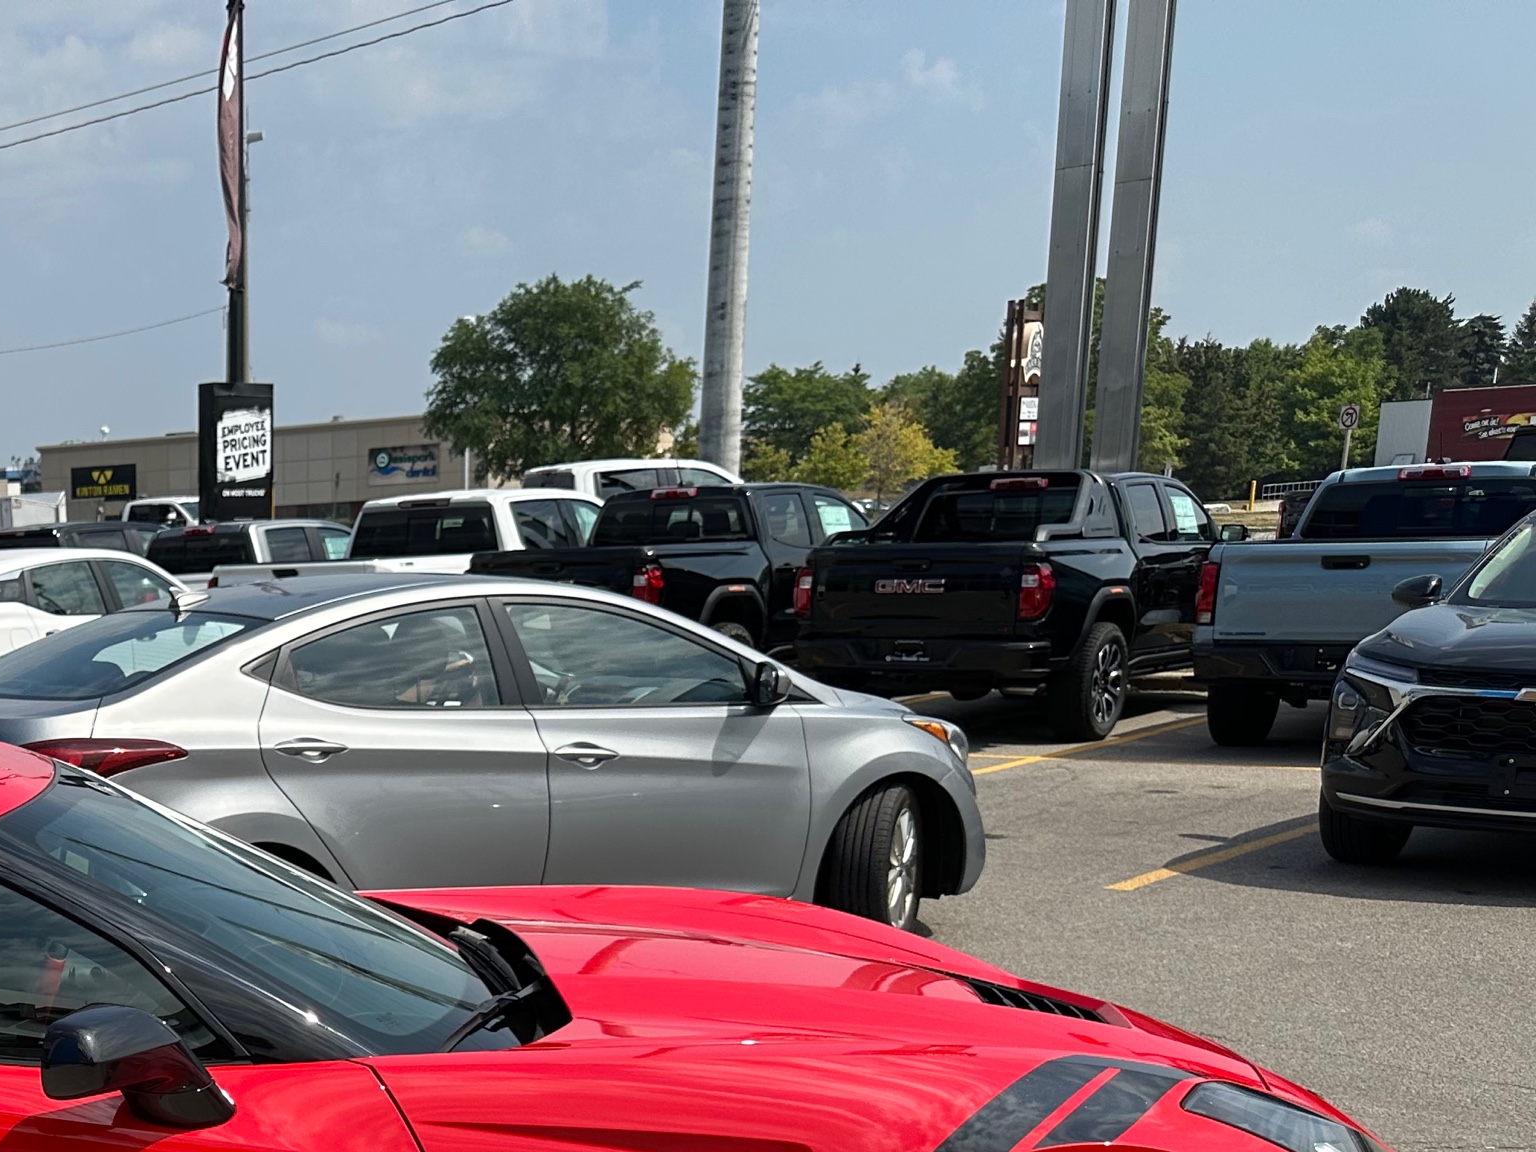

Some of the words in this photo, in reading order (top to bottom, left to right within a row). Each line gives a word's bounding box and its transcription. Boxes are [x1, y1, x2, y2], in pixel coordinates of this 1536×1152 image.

[221, 420, 266, 438] EMPLOYEE
[223, 433, 267, 453] PRICING
[224, 449, 267, 472] EVENT
[875, 579, 945, 594] GMC
